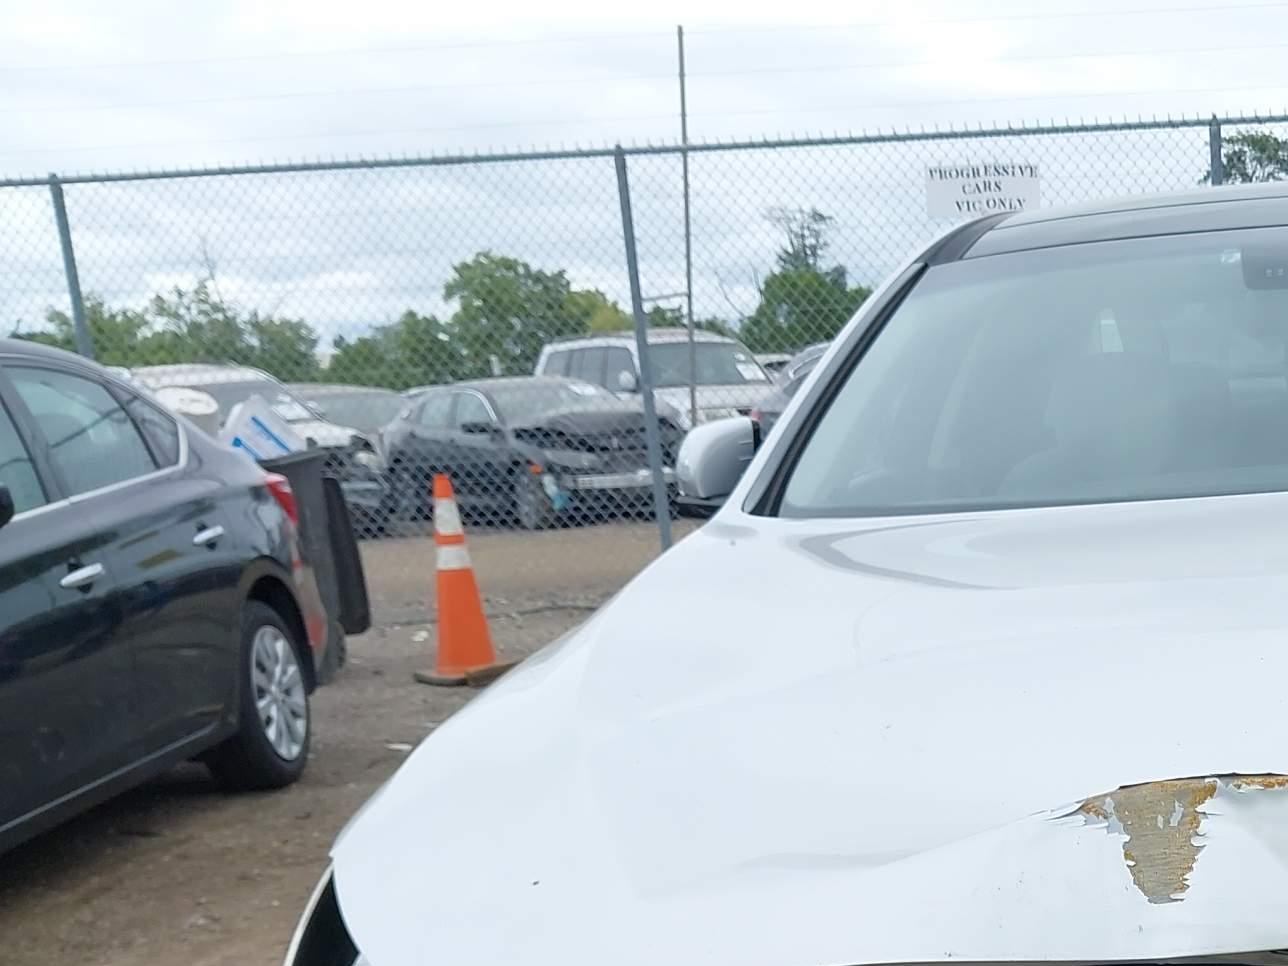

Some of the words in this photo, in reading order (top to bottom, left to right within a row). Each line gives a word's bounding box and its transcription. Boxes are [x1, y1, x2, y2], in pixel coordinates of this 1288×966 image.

[929, 164, 1038, 180] PROGRESSIVE
[961, 179, 1002, 195] CARS
[985, 197, 1027, 211] ONLY
